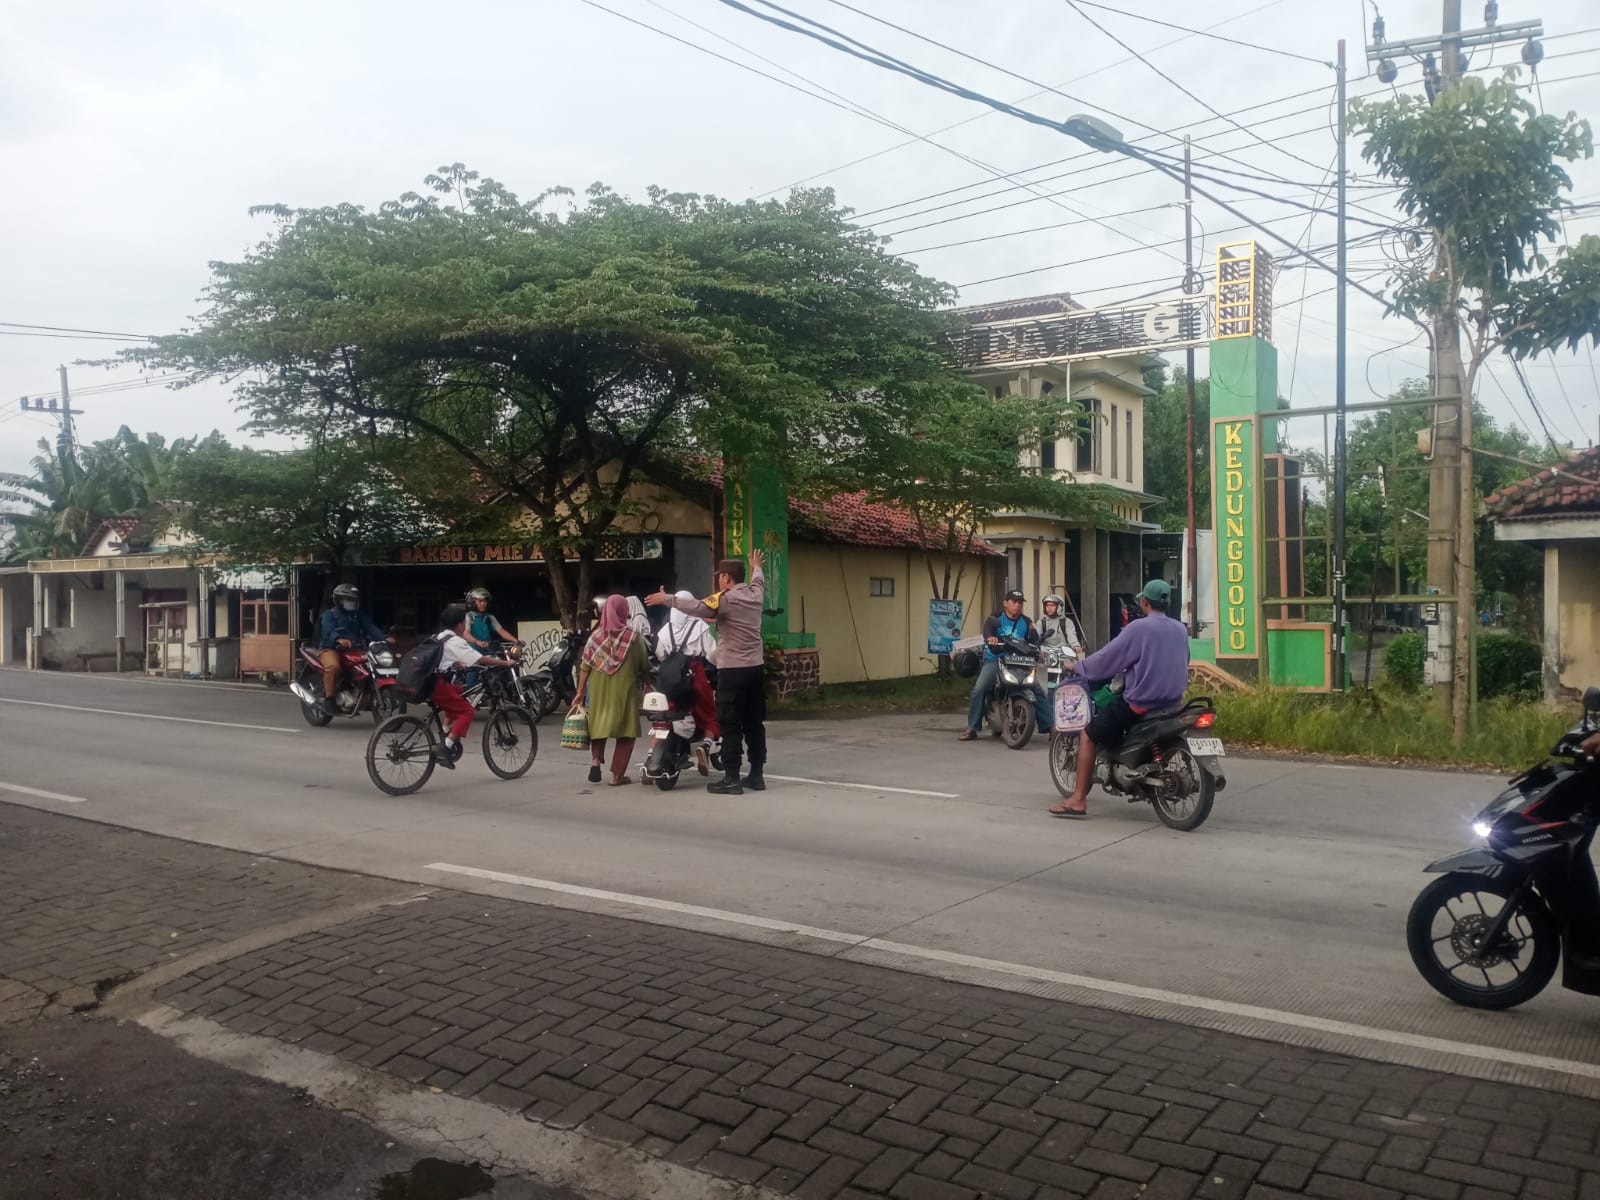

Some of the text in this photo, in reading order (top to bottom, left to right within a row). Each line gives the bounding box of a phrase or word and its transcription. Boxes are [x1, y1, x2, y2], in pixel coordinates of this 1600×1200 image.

[731, 466, 745, 557] ASUK
[1224, 422, 1247, 651] KEDUNGDOWO
[400, 544, 463, 562] BAKSO
[484, 544, 523, 561] MIE
[1521, 832, 1553, 844] HONDA
